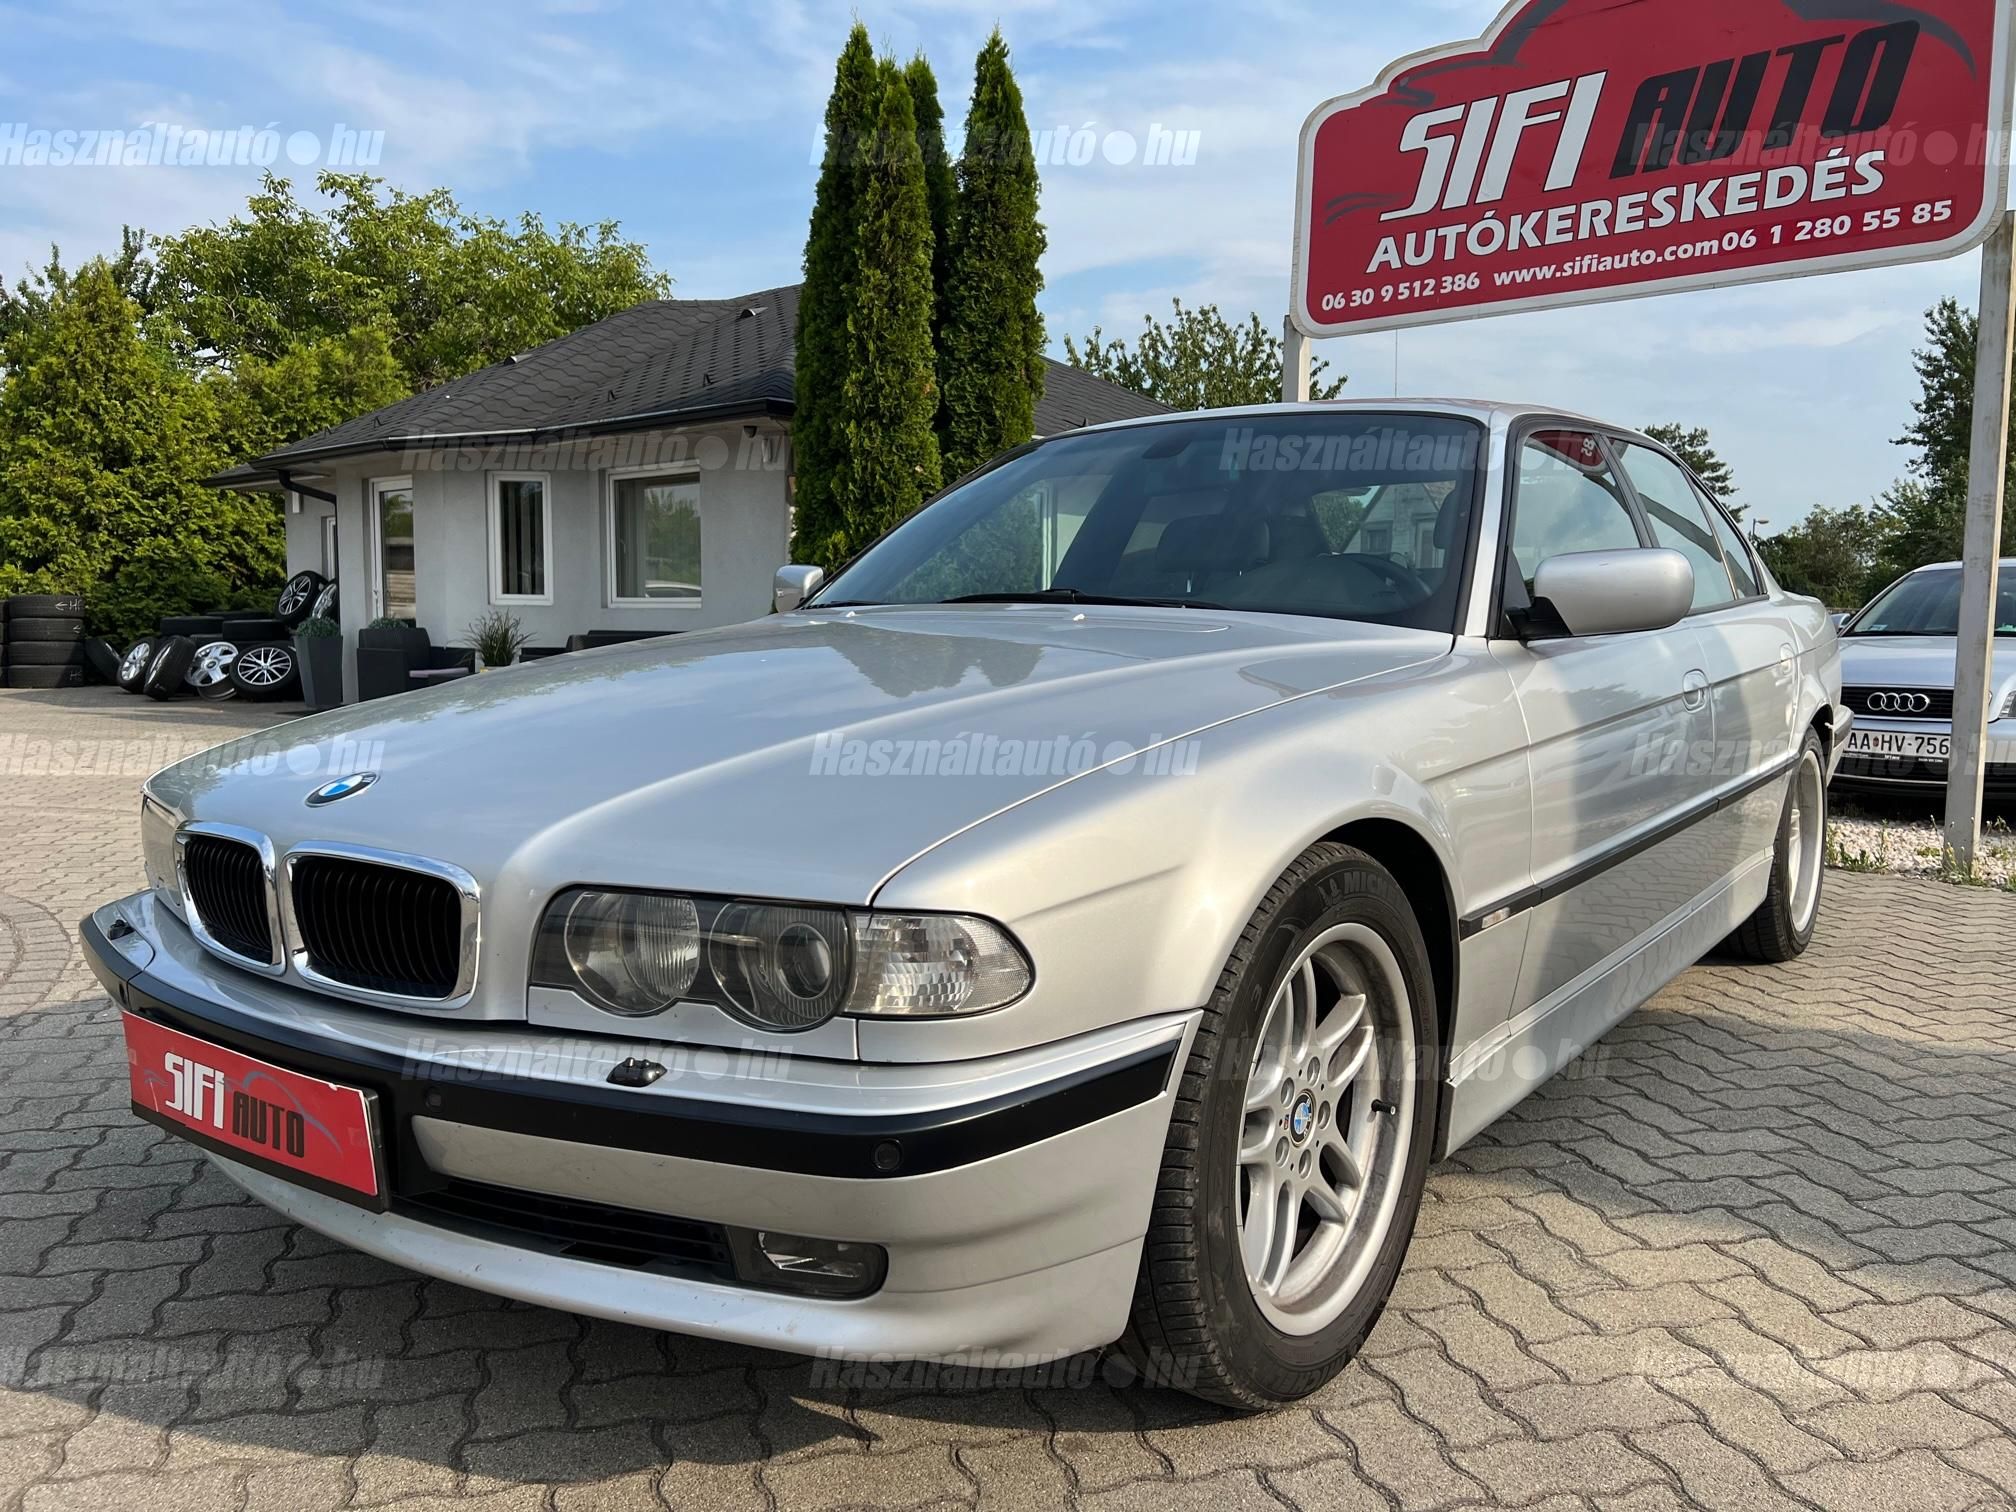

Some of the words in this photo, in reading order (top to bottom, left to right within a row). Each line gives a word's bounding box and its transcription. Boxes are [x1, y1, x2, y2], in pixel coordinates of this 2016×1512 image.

[1379, 70, 1608, 222] SIFI
[1609, 19, 1920, 179] AUTO
[1321, 292, 1346, 311] 06
[1350, 288, 1374, 307] 30
[1381, 285, 1394, 302] 9
[1398, 279, 1436, 300] 512
[1440, 272, 1480, 294] 386
[1493, 239, 1718, 286] www.sifiauto.com
[1721, 229, 1757, 251] 06
[1770, 225, 1782, 244] 1
[1794, 215, 1852, 241] 280
[1862, 208, 1900, 231] 55
[1911, 200, 1952, 223] 85
[1365, 148, 1885, 274] AUTÓKERESKEDÉS
[1848, 732, 1871, 749] AA
[1881, 734, 1949, 755] HV-756
[164, 1051, 225, 1130] SIFI
[232, 1091, 304, 1158] AUTO
